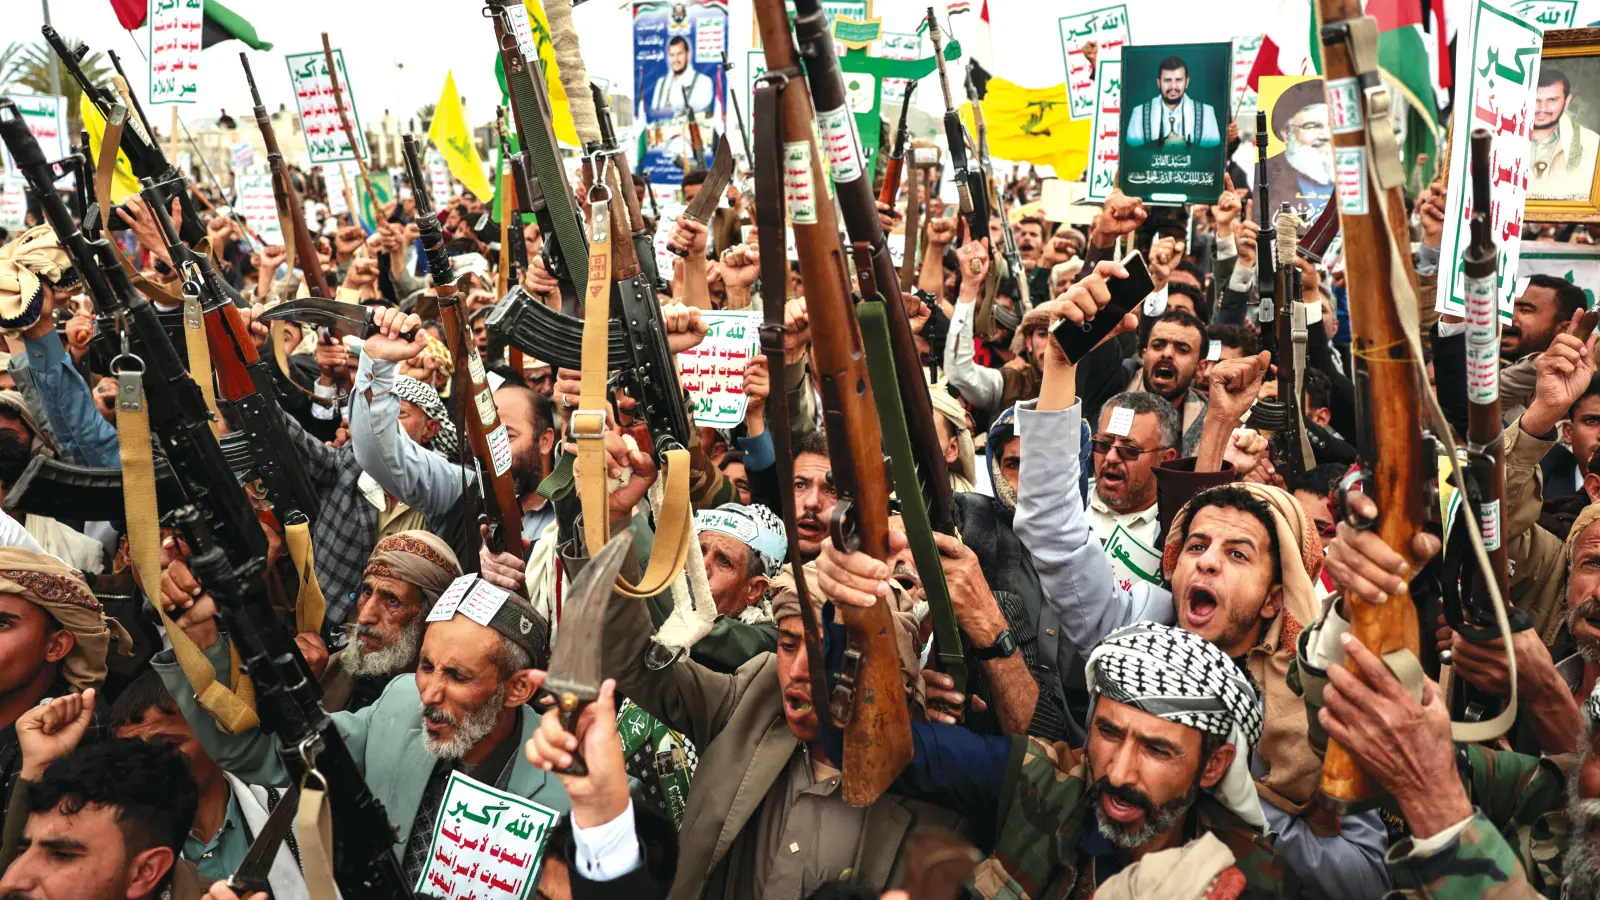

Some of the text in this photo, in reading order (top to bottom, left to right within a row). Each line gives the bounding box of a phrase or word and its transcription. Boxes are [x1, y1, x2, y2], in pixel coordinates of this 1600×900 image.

[1066, 12, 1124, 42] الله أكبر
[1477, 37, 1541, 89] أكبر
[719, 347, 750, 360] الموت
[679, 363, 716, 379] لإسرائيل
[706, 381, 722, 395] على
[714, 399, 744, 418] النصر
[447, 800, 545, 843] الله أكبر
[441, 819, 532, 870] الموت لأمريكا
[428, 868, 456, 897] اليهود
[435, 845, 523, 896] الموت لإسرائيل
